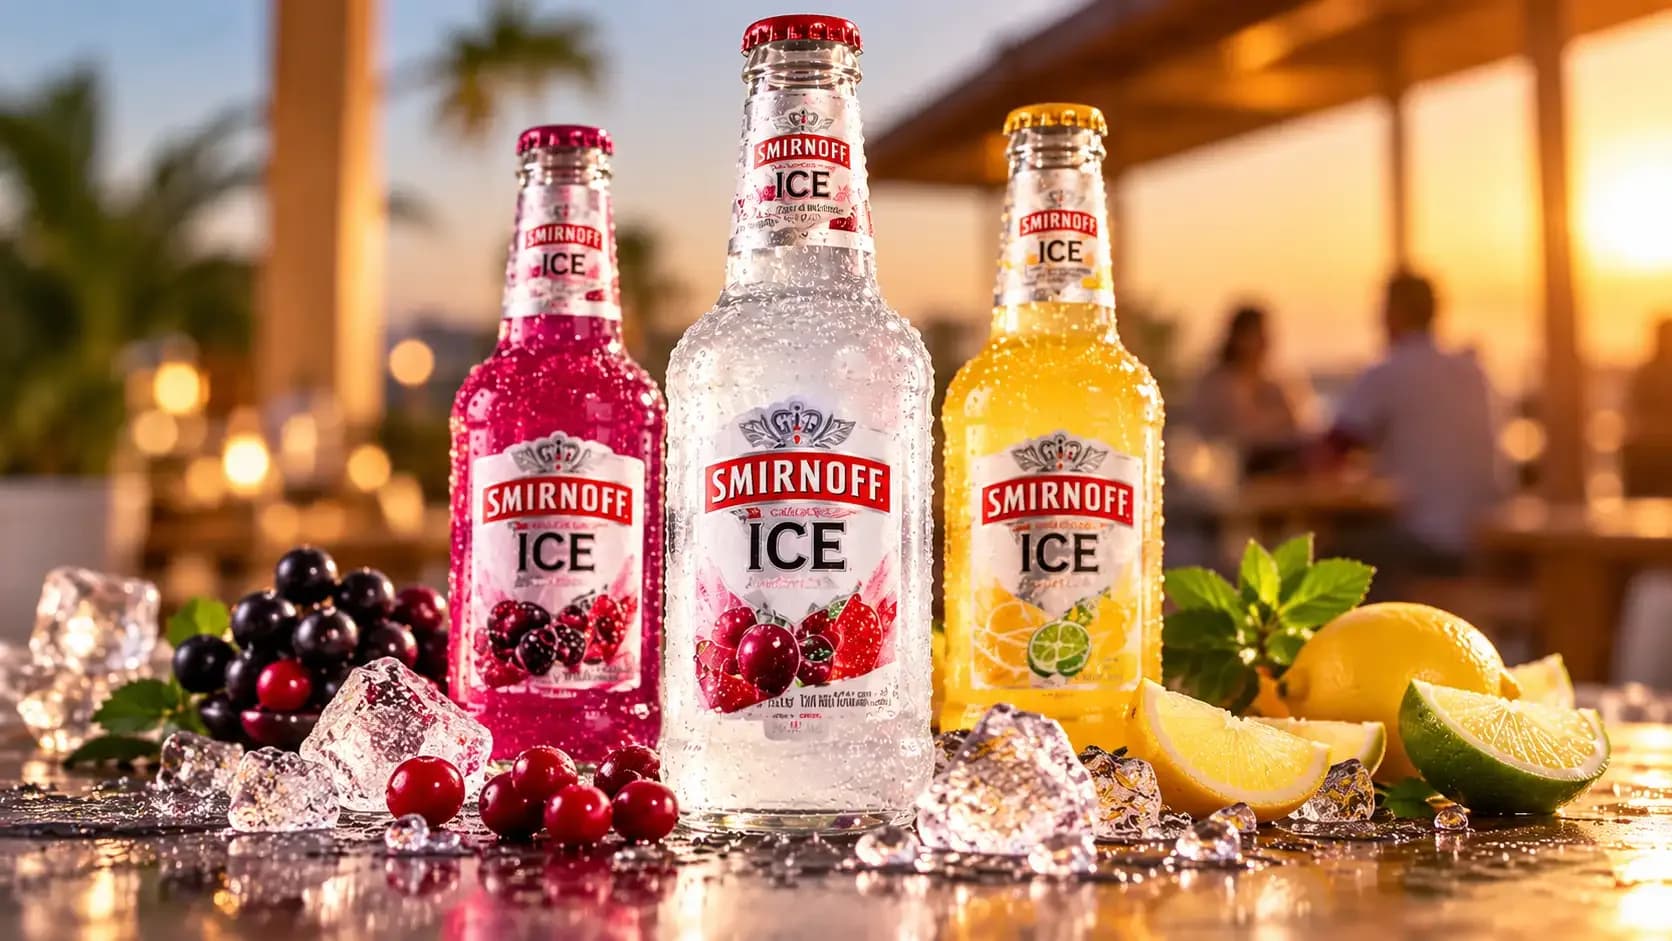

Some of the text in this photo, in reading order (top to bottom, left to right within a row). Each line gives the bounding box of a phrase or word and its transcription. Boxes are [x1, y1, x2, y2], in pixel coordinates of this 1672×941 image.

[776, 170, 830, 198] ICE
[1021, 212, 1096, 233] SMIRNOFF
[527, 226, 601, 249] SMIRNOFF
[542, 252, 586, 277] ICE
[1039, 240, 1083, 263] ICE
[517, 531, 595, 572] ICE
[748, 521, 846, 571] ICE
[1020, 532, 1099, 573] ICE
